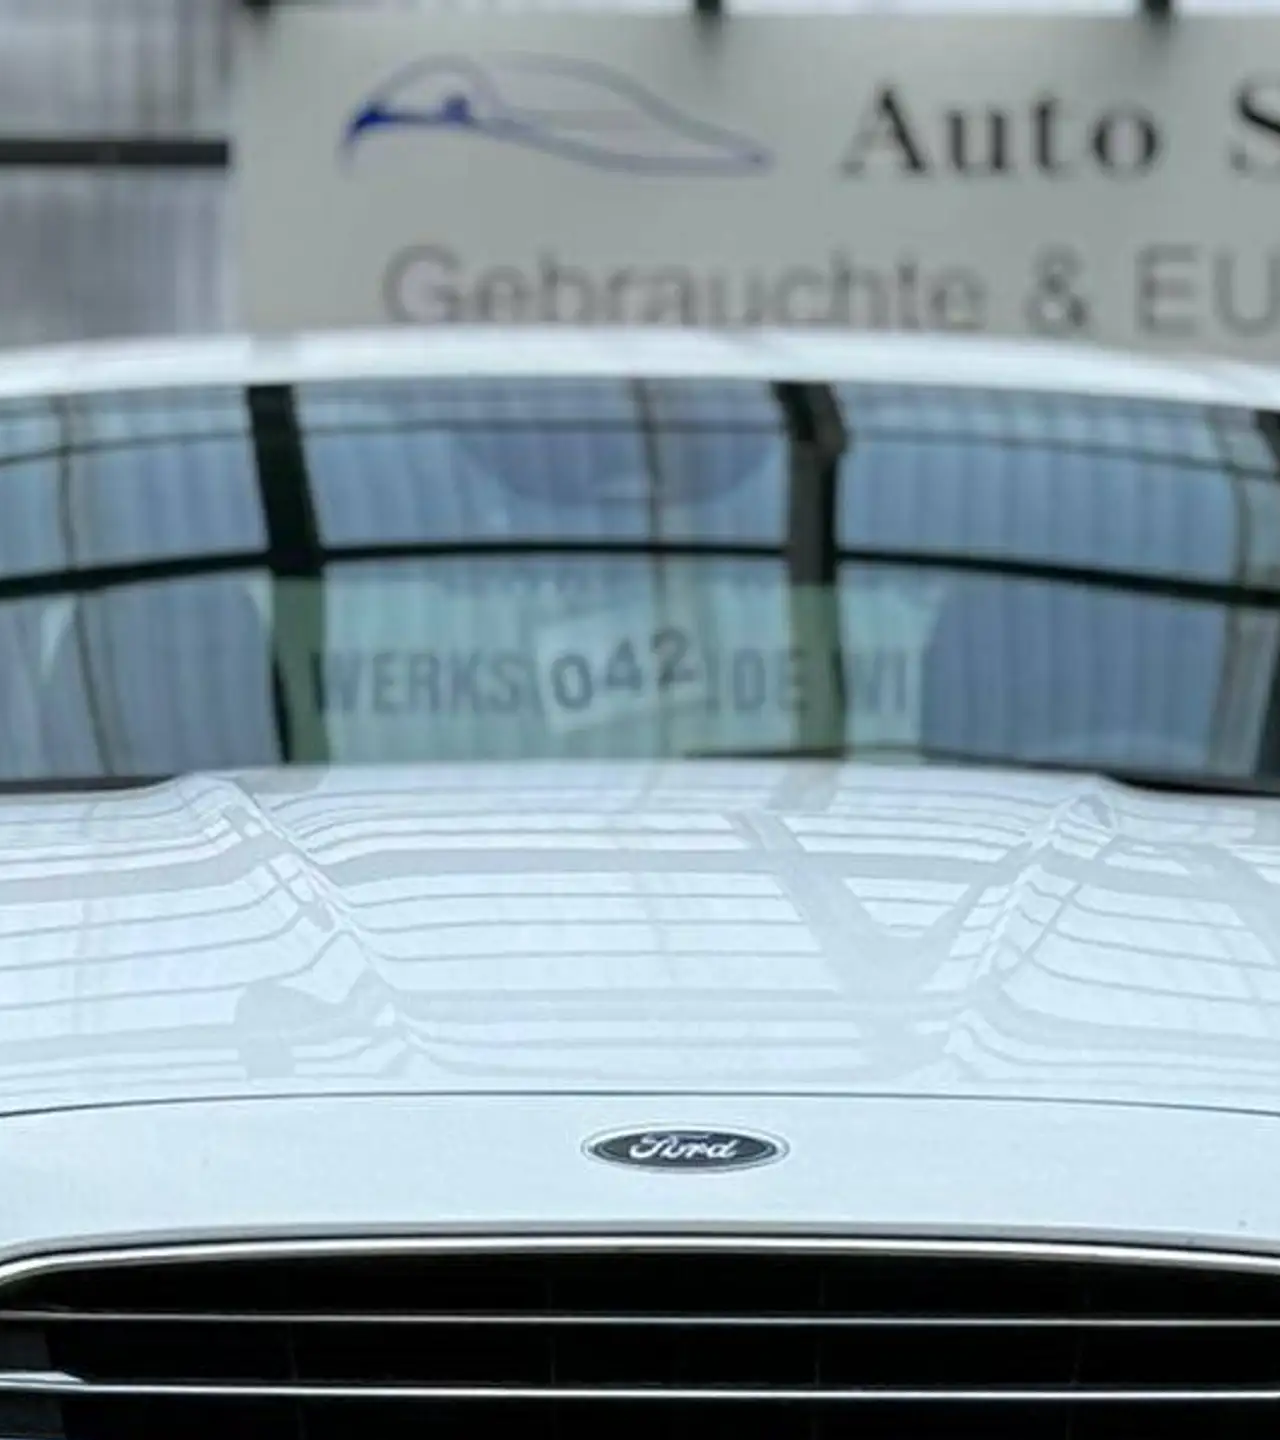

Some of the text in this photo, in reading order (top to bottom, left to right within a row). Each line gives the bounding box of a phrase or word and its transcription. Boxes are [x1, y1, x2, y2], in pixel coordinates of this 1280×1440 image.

[842, 83, 1160, 178] Auto
[382, 242, 986, 330] Gebrauchte
[1026, 246, 1090, 335] &
[550, 625, 705, 713] 042
[628, 1133, 742, 1160] Ford
